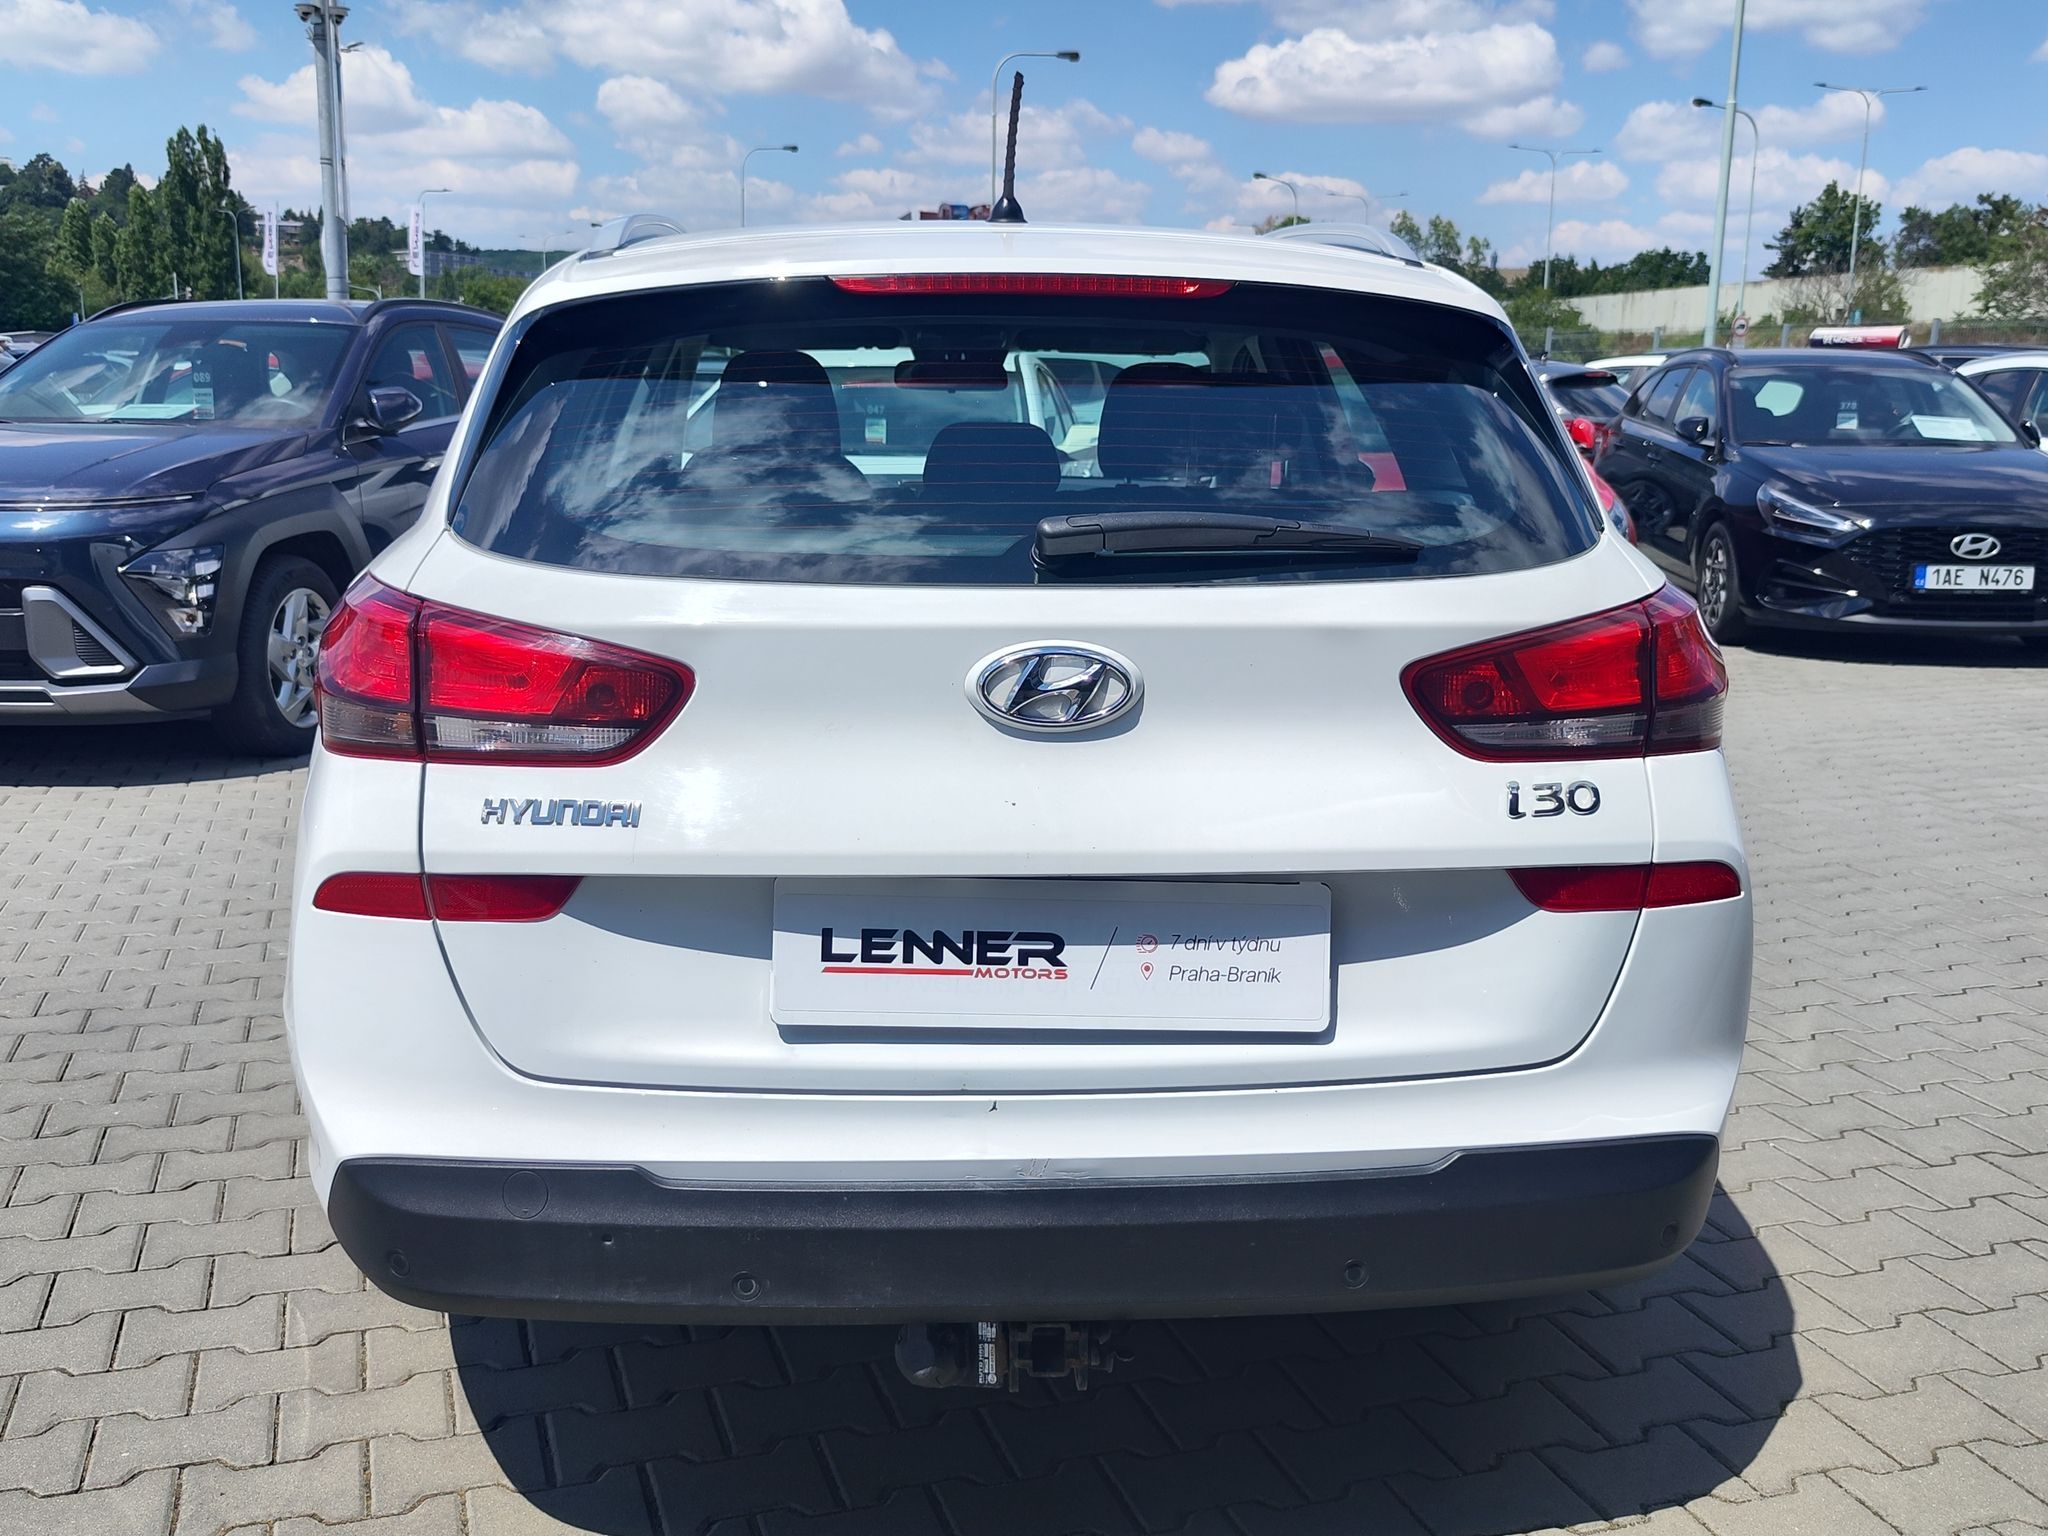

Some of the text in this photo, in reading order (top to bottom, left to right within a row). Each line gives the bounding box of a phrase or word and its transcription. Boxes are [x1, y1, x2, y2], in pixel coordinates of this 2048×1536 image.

[1932, 568, 2025, 587] 1AE N476
[1507, 780, 1600, 819] i30
[481, 798, 642, 828] HYUNDAI
[820, 927, 1068, 967] LENNER
[1171, 934, 1281, 956] 7 dní v týdnu
[974, 967, 1069, 980] MOTORS
[1168, 964, 1282, 983] Praha-Braník
